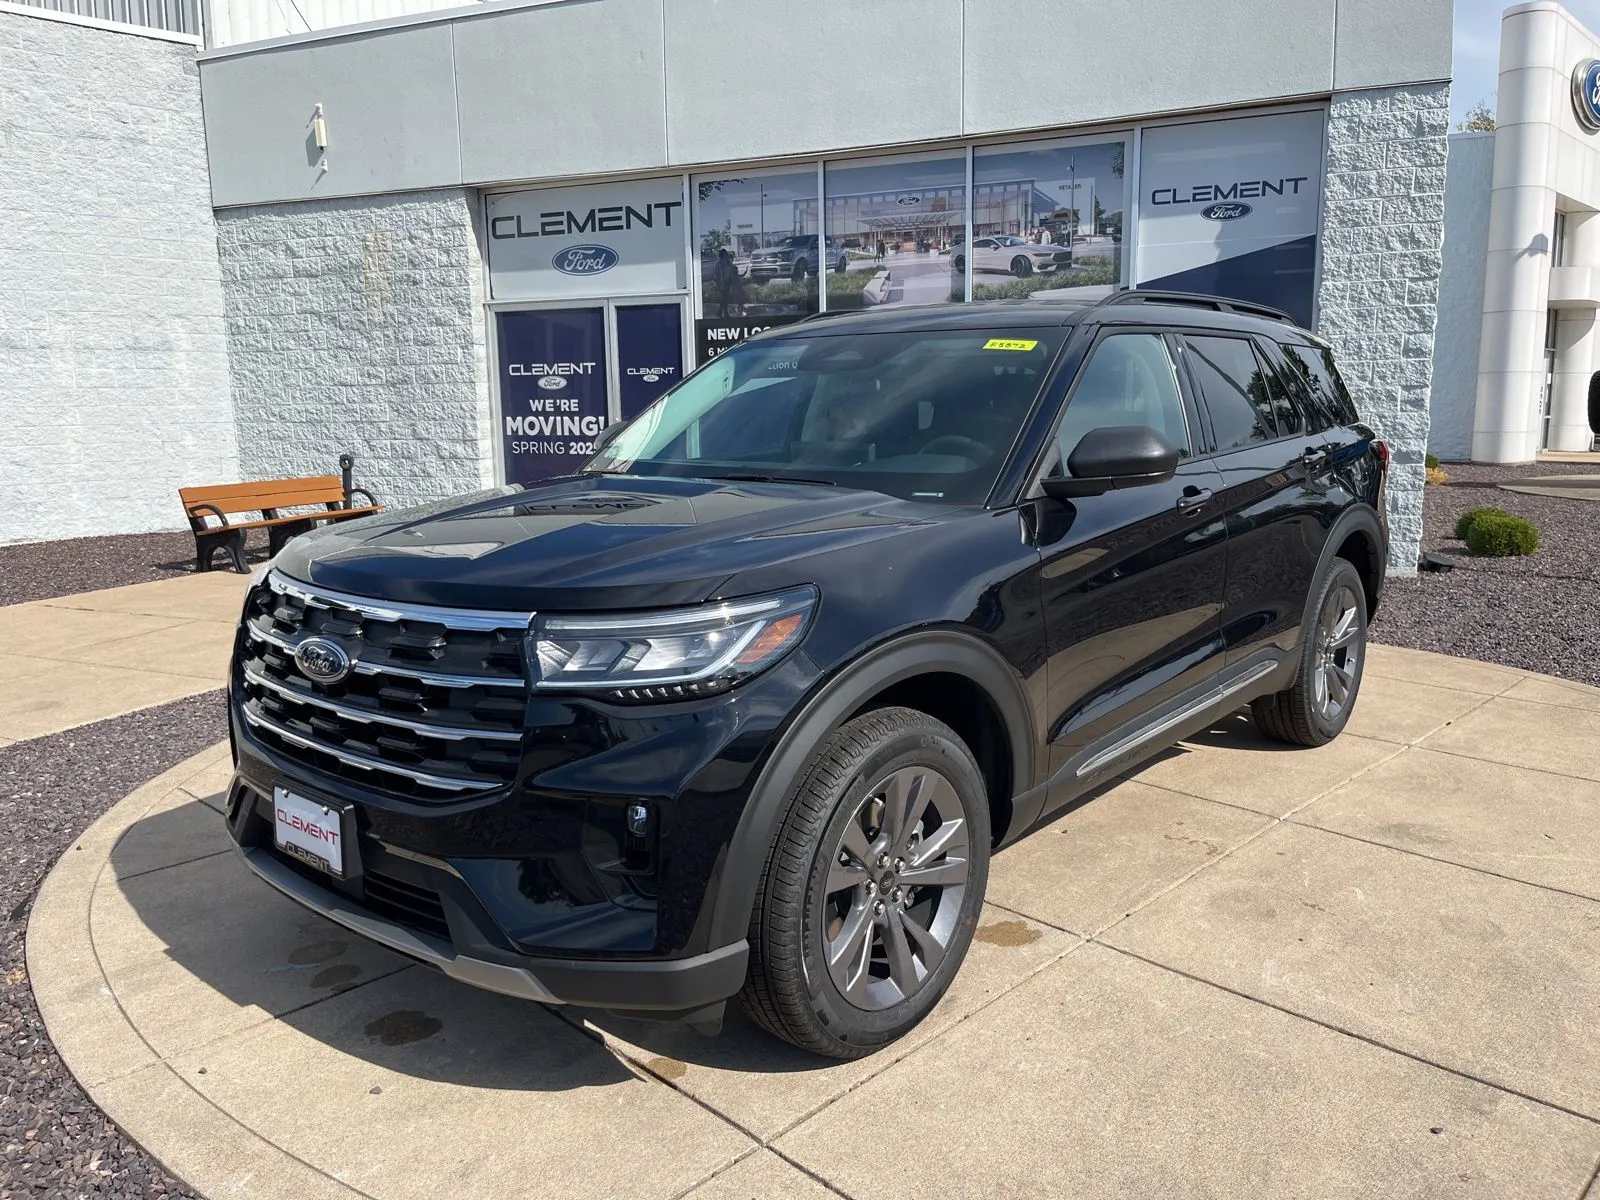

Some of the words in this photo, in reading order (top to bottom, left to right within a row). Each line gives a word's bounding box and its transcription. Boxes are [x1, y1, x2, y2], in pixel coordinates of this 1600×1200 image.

[1151, 177, 1308, 206] CLEMENT
[491, 201, 682, 240] CLEMENT
[1210, 204, 1242, 219] Ford
[564, 249, 606, 271] Ford
[707, 327, 741, 341] NEW
[708, 347, 715, 357] 6
[508, 362, 596, 376] CLEMENT
[627, 367, 675, 375] CLEMENT
[505, 415, 605, 436] MOVING!
[512, 441, 565, 455] SPRING
[303, 646, 332, 672] Ford
[277, 808, 339, 845] CLEMENT
[287, 843, 330, 872] CLEMENT
